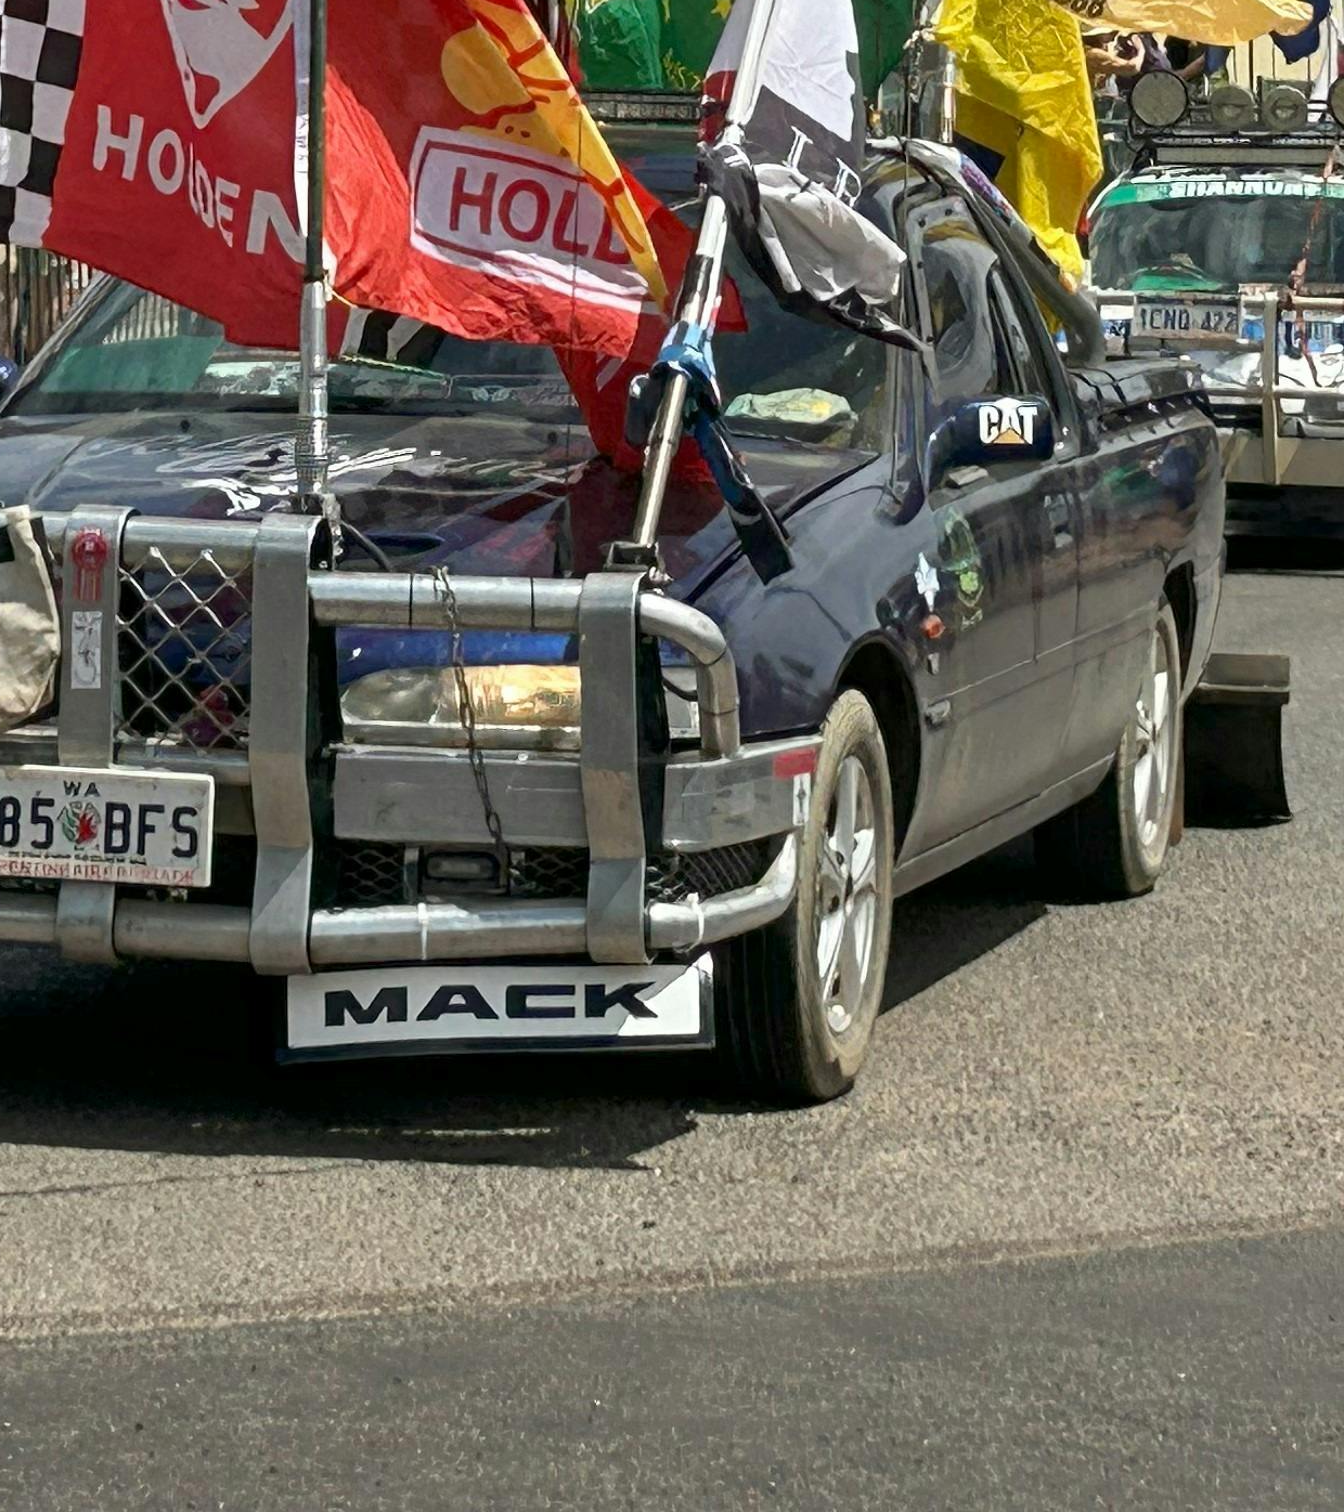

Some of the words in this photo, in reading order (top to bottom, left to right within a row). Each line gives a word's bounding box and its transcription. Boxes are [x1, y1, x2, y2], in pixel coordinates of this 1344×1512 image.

[979, 404, 1038, 445] CAT
[63, 779, 100, 798] WA
[324, 982, 658, 1026] MACK
